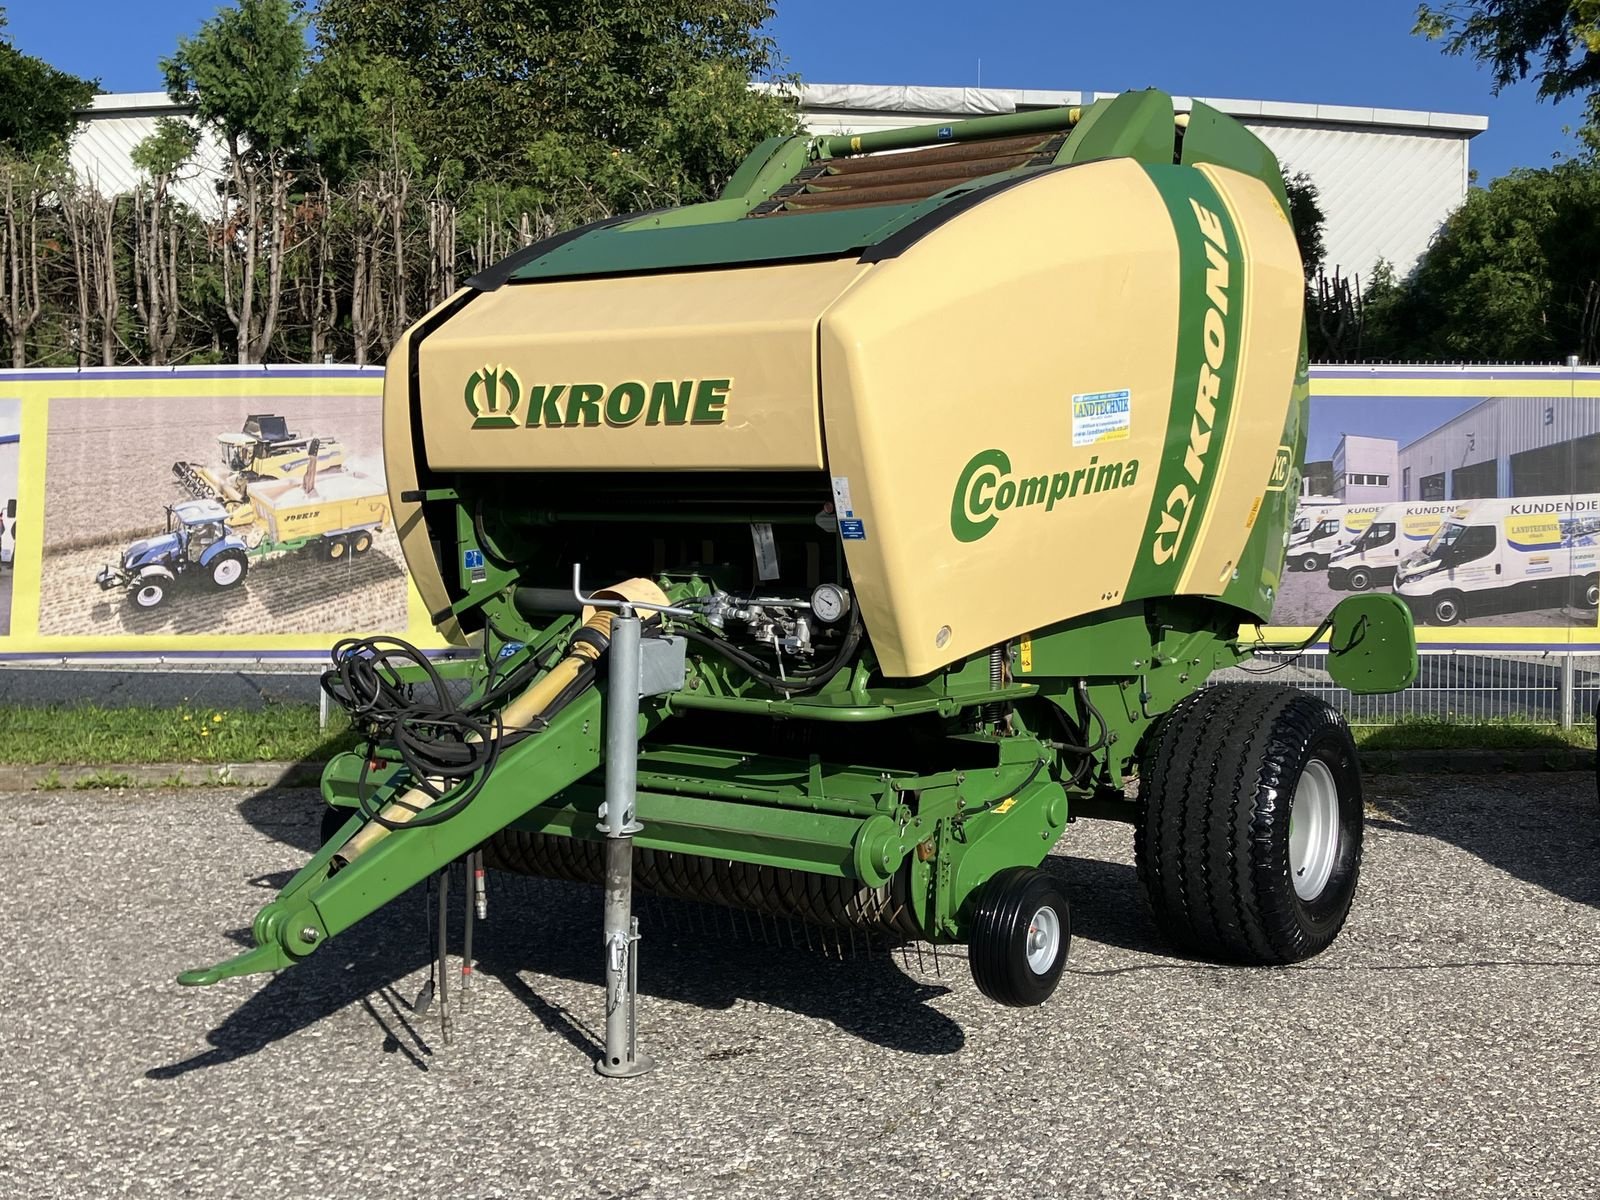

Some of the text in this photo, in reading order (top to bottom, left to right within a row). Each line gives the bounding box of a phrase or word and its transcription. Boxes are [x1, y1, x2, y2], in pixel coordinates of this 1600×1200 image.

[1184, 197, 1230, 485] KRONE
[525, 378, 734, 428] KRONE
[1074, 398, 1129, 418] LANDTECHNIK
[1510, 501, 1599, 515] KUNDENDIE
